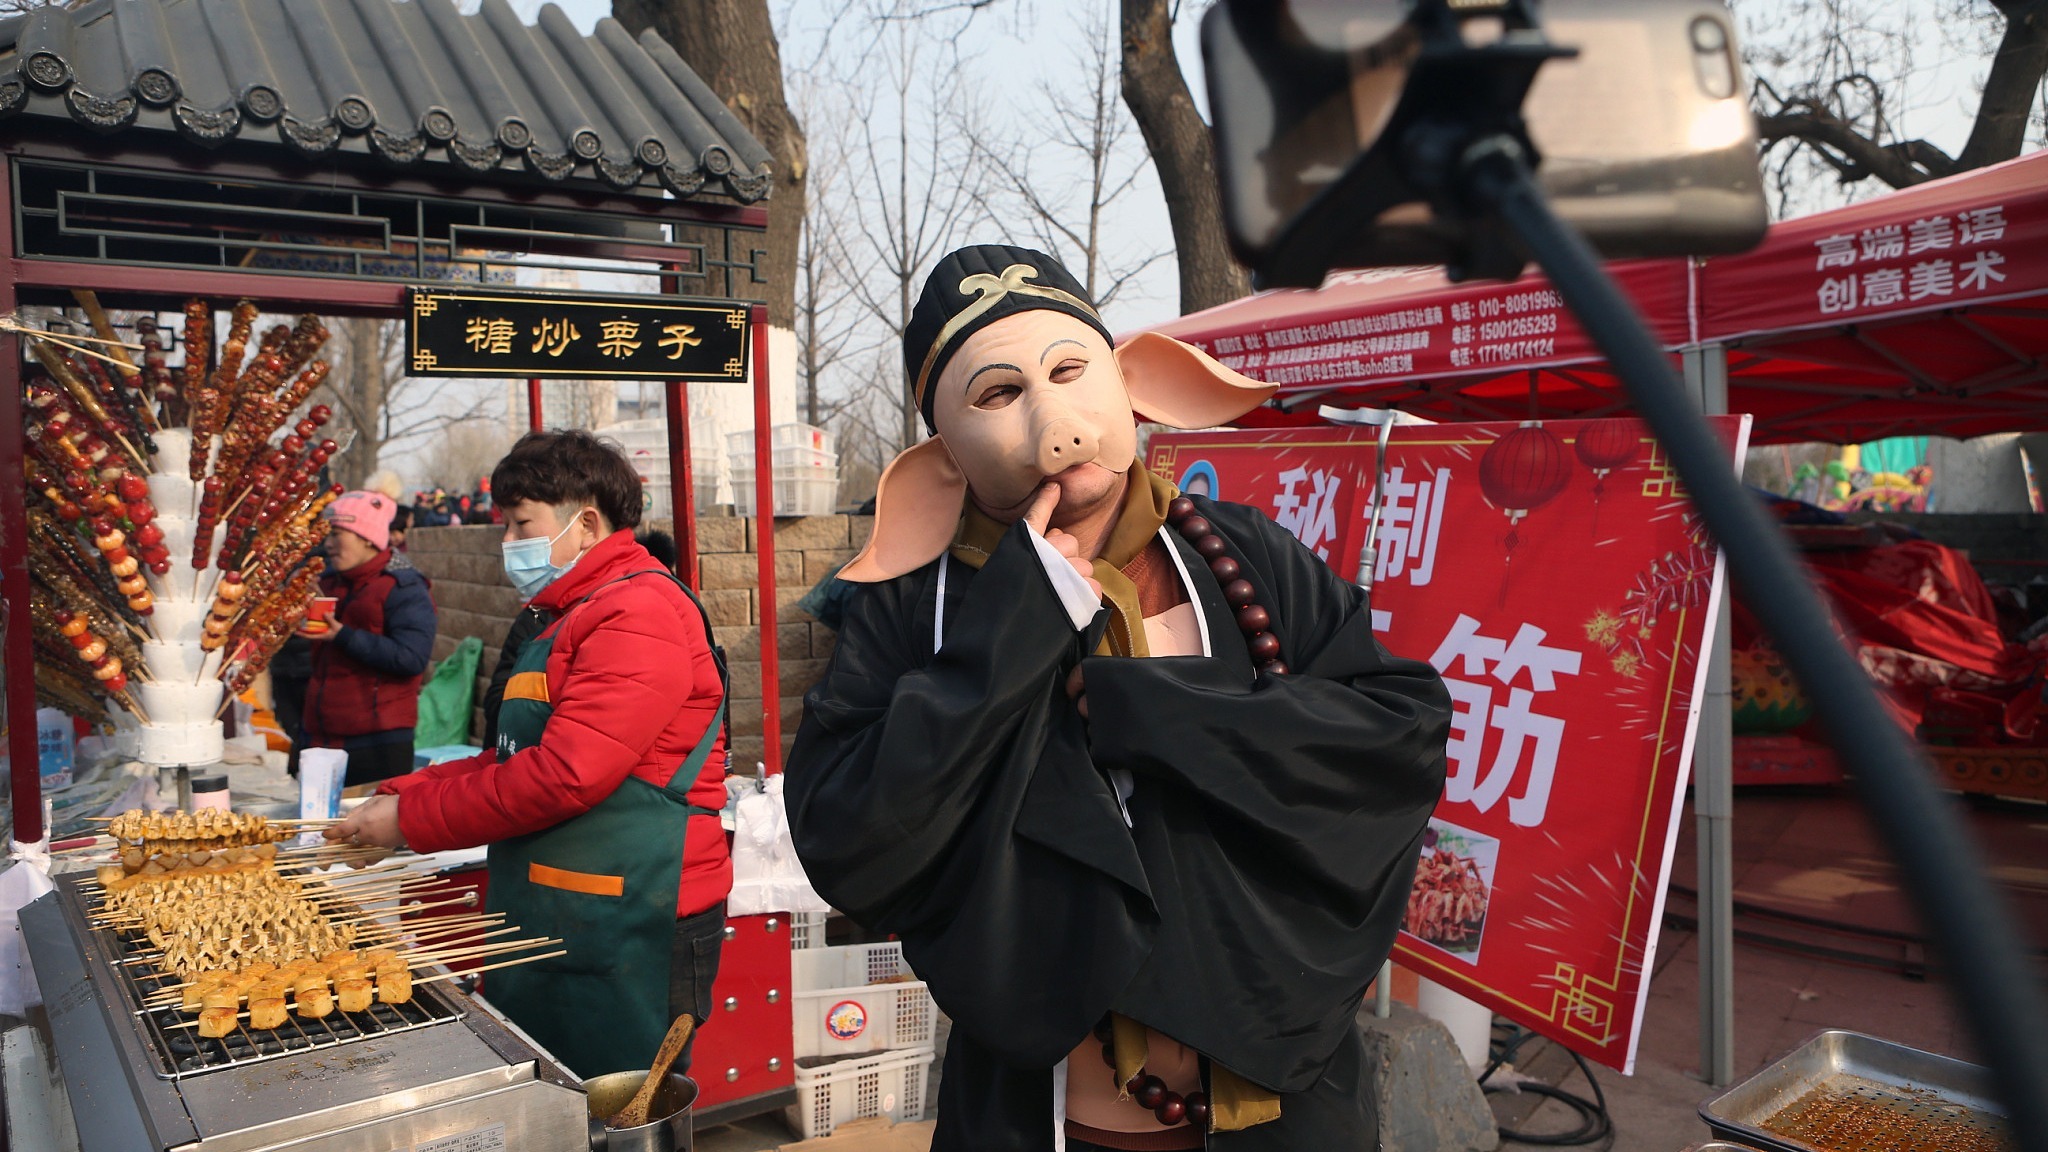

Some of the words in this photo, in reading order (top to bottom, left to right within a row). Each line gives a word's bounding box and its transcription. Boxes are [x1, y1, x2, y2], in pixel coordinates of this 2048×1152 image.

[1814, 205, 2007, 272] 高端美语
[1816, 251, 2007, 314] 创意美术
[465, 316, 702, 360] 糖炒栗子
[1478, 337, 1554, 364] 17718474124
[1479, 313, 1557, 340] 15001265293
[1272, 464, 1451, 586] 秘制
